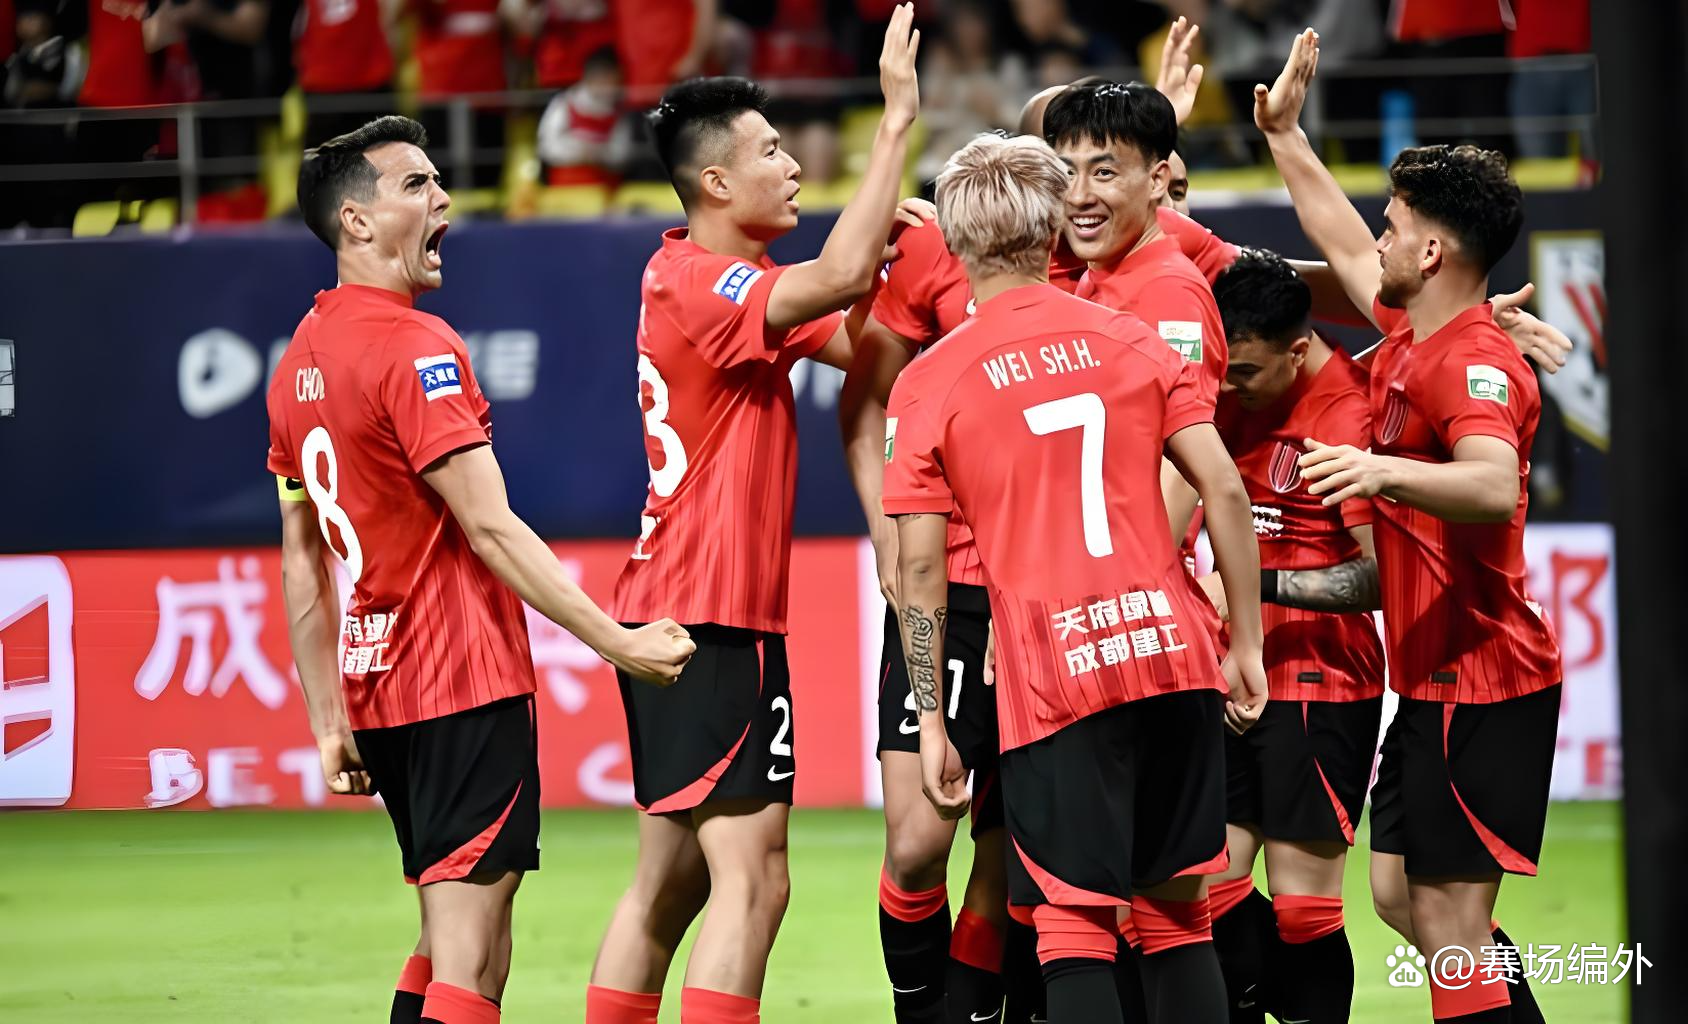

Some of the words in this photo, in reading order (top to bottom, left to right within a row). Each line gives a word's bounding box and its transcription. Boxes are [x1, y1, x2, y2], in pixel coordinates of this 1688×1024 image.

[982, 351, 1034, 389] WEI
[1039, 338, 1101, 375] SH.H.
[301, 426, 363, 584] 8
[1022, 392, 1113, 558] 7
[769, 696, 791, 756] 2
